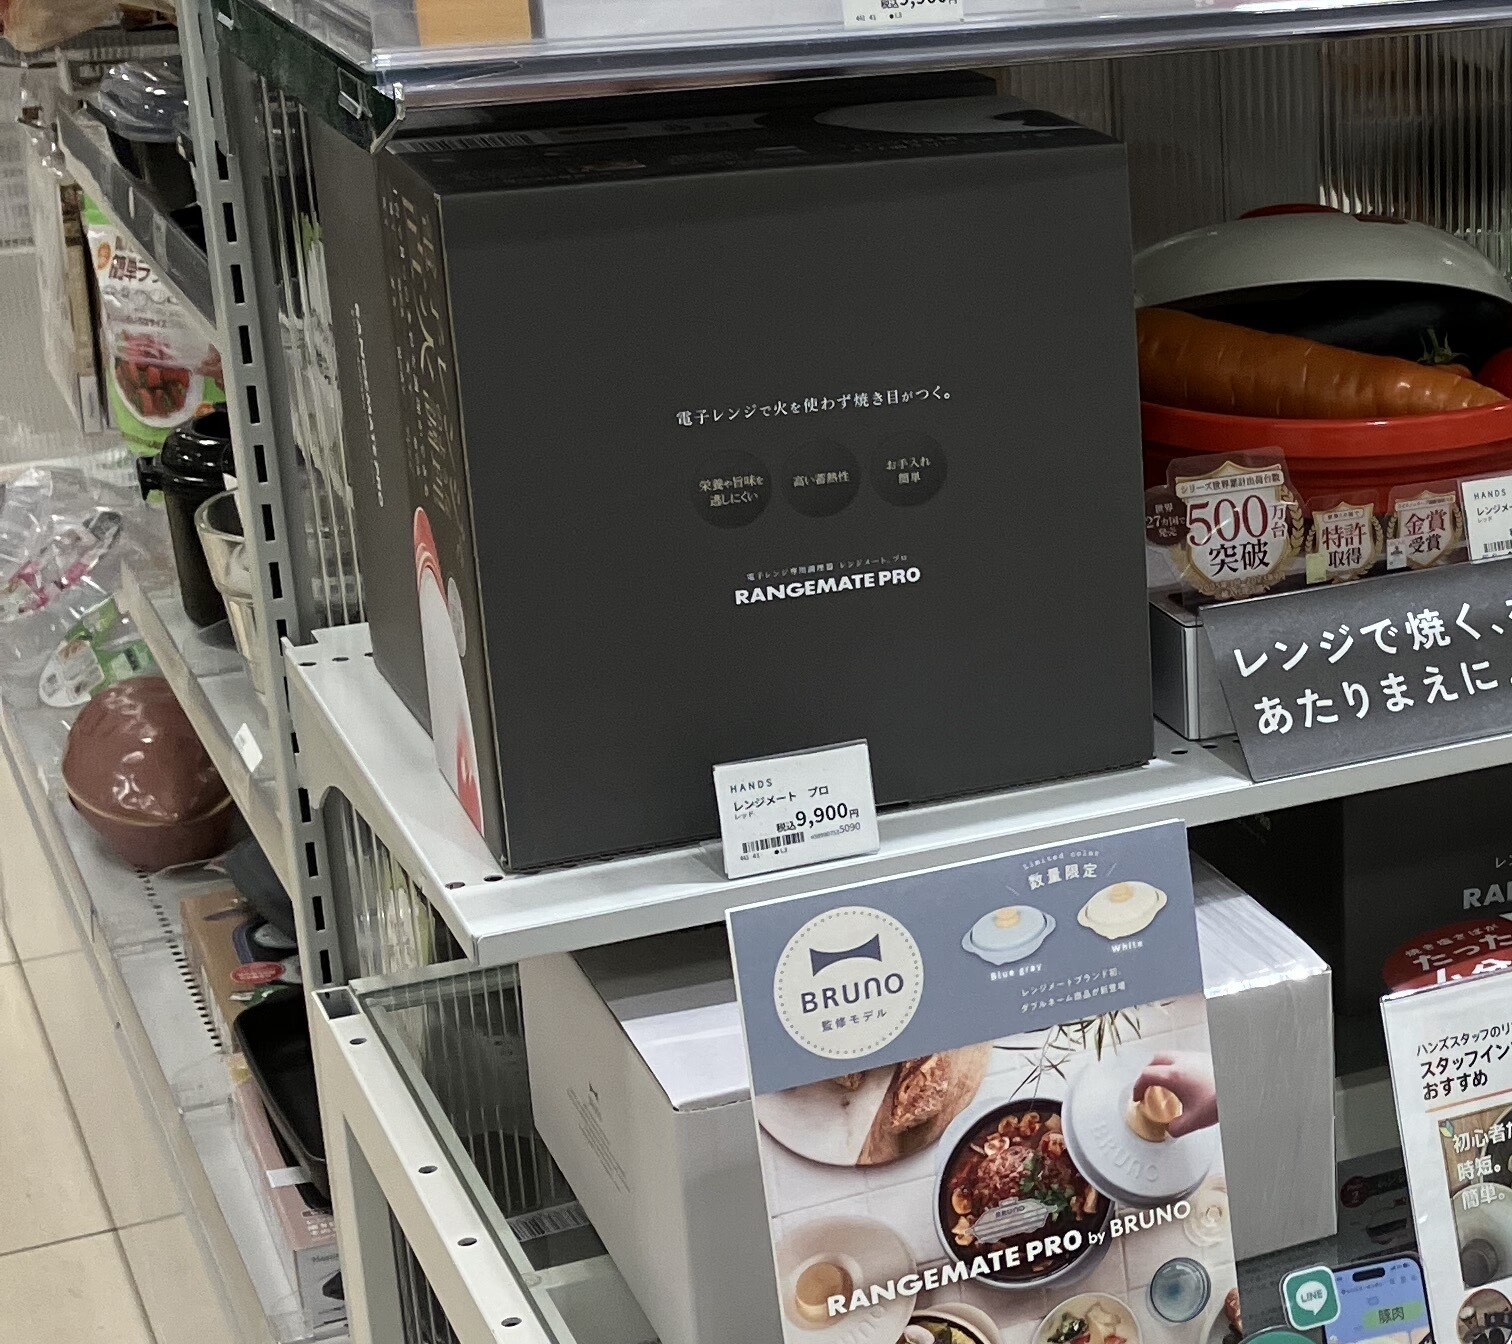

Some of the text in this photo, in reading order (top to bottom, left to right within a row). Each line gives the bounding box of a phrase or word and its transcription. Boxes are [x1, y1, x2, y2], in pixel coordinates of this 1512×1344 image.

[676, 385, 952, 427] 電子レンジで火を使わず焼き目がつく。
[886, 456, 931, 471] お手入れ
[699, 474, 765, 493] 栄養や旨味を
[793, 470, 850, 488] 高い蓄熱性
[898, 471, 921, 485] 簡単
[1180, 471, 1281, 494] シリーズ世界累計出荷台数
[1473, 488, 1508, 500] HANDS
[1187, 494, 1269, 547] 500
[1404, 508, 1448, 537] 金賞
[1321, 520, 1368, 550] 特許
[1408, 532, 1442, 555] 受賞
[1207, 540, 1271, 576] 突破
[1327, 545, 1363, 568] 取得
[735, 566, 921, 605] RANGEMATE PRO
[729, 777, 774, 795] HANDS
[733, 783, 830, 813] レンジメート プロ
[1027, 861, 1100, 891] 数量限定
[1111, 940, 1144, 954] White
[990, 962, 1043, 982] Blue gray
[800, 972, 905, 1014] BRUNO
[1021, 981, 1128, 1014] ダブルネーム商品が新登場
[820, 1009, 888, 1033] 監修モデル
[1421, 1070, 1489, 1101] おすすめ
[1457, 1160, 1502, 1183] 時短。
[1461, 1188, 1507, 1211] 簡単。
[826, 1200, 1192, 1317] RANGEMATE PRO by BRUNO
[1300, 1289, 1324, 1304] LINE
